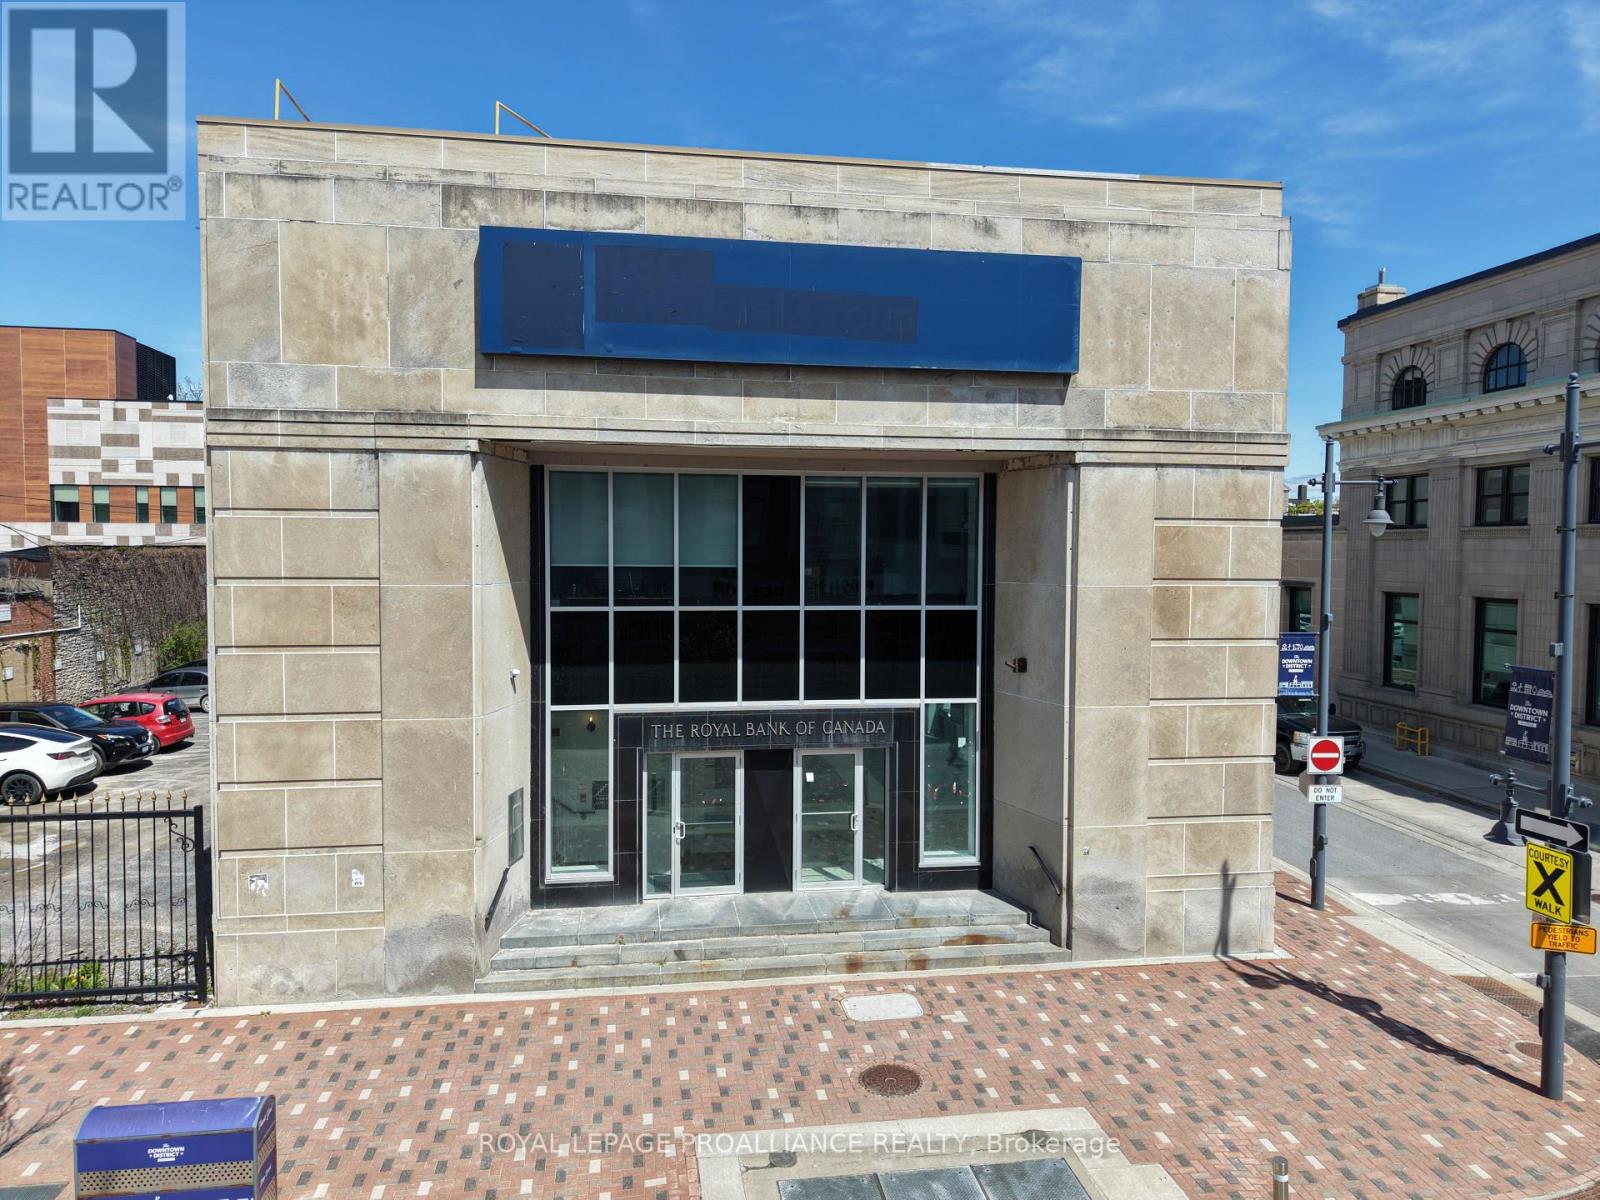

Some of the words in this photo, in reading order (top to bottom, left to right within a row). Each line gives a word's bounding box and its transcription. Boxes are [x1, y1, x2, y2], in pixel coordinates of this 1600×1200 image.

[1510, 704, 1549, 717] DOWNTOWN
[1514, 712, 1542, 722] DISTRICT
[651, 724, 683, 738] THE
[690, 723, 741, 738] ROYAL
[746, 721, 791, 736] BANK
[796, 720, 815, 735] OF
[822, 720, 886, 735] CANADA
[1528, 847, 1570, 869] COURTESY
[1534, 897, 1562, 917] WALK
[1538, 927, 1589, 937] PEDESTRIANS
[1549, 940, 1579, 950] TRAFFIC
